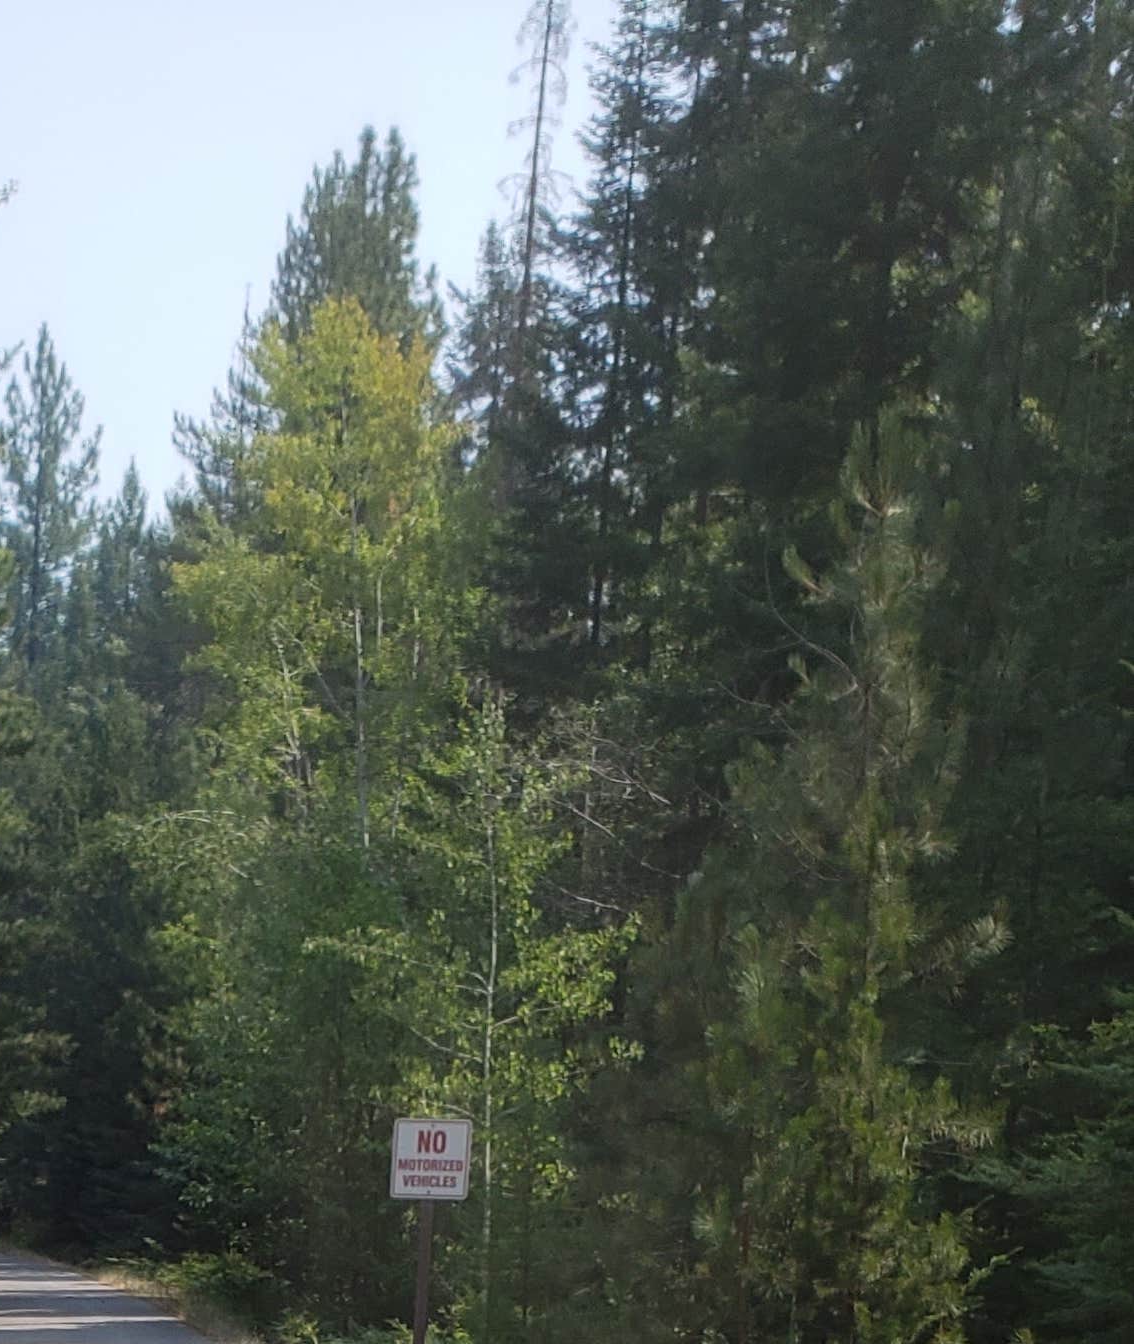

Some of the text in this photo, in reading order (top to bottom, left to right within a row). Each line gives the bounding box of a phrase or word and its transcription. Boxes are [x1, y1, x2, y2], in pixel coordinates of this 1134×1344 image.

[417, 1130, 446, 1154] NO
[398, 1159, 463, 1172] MOTORIZED
[403, 1175, 457, 1188] VEHICLES
